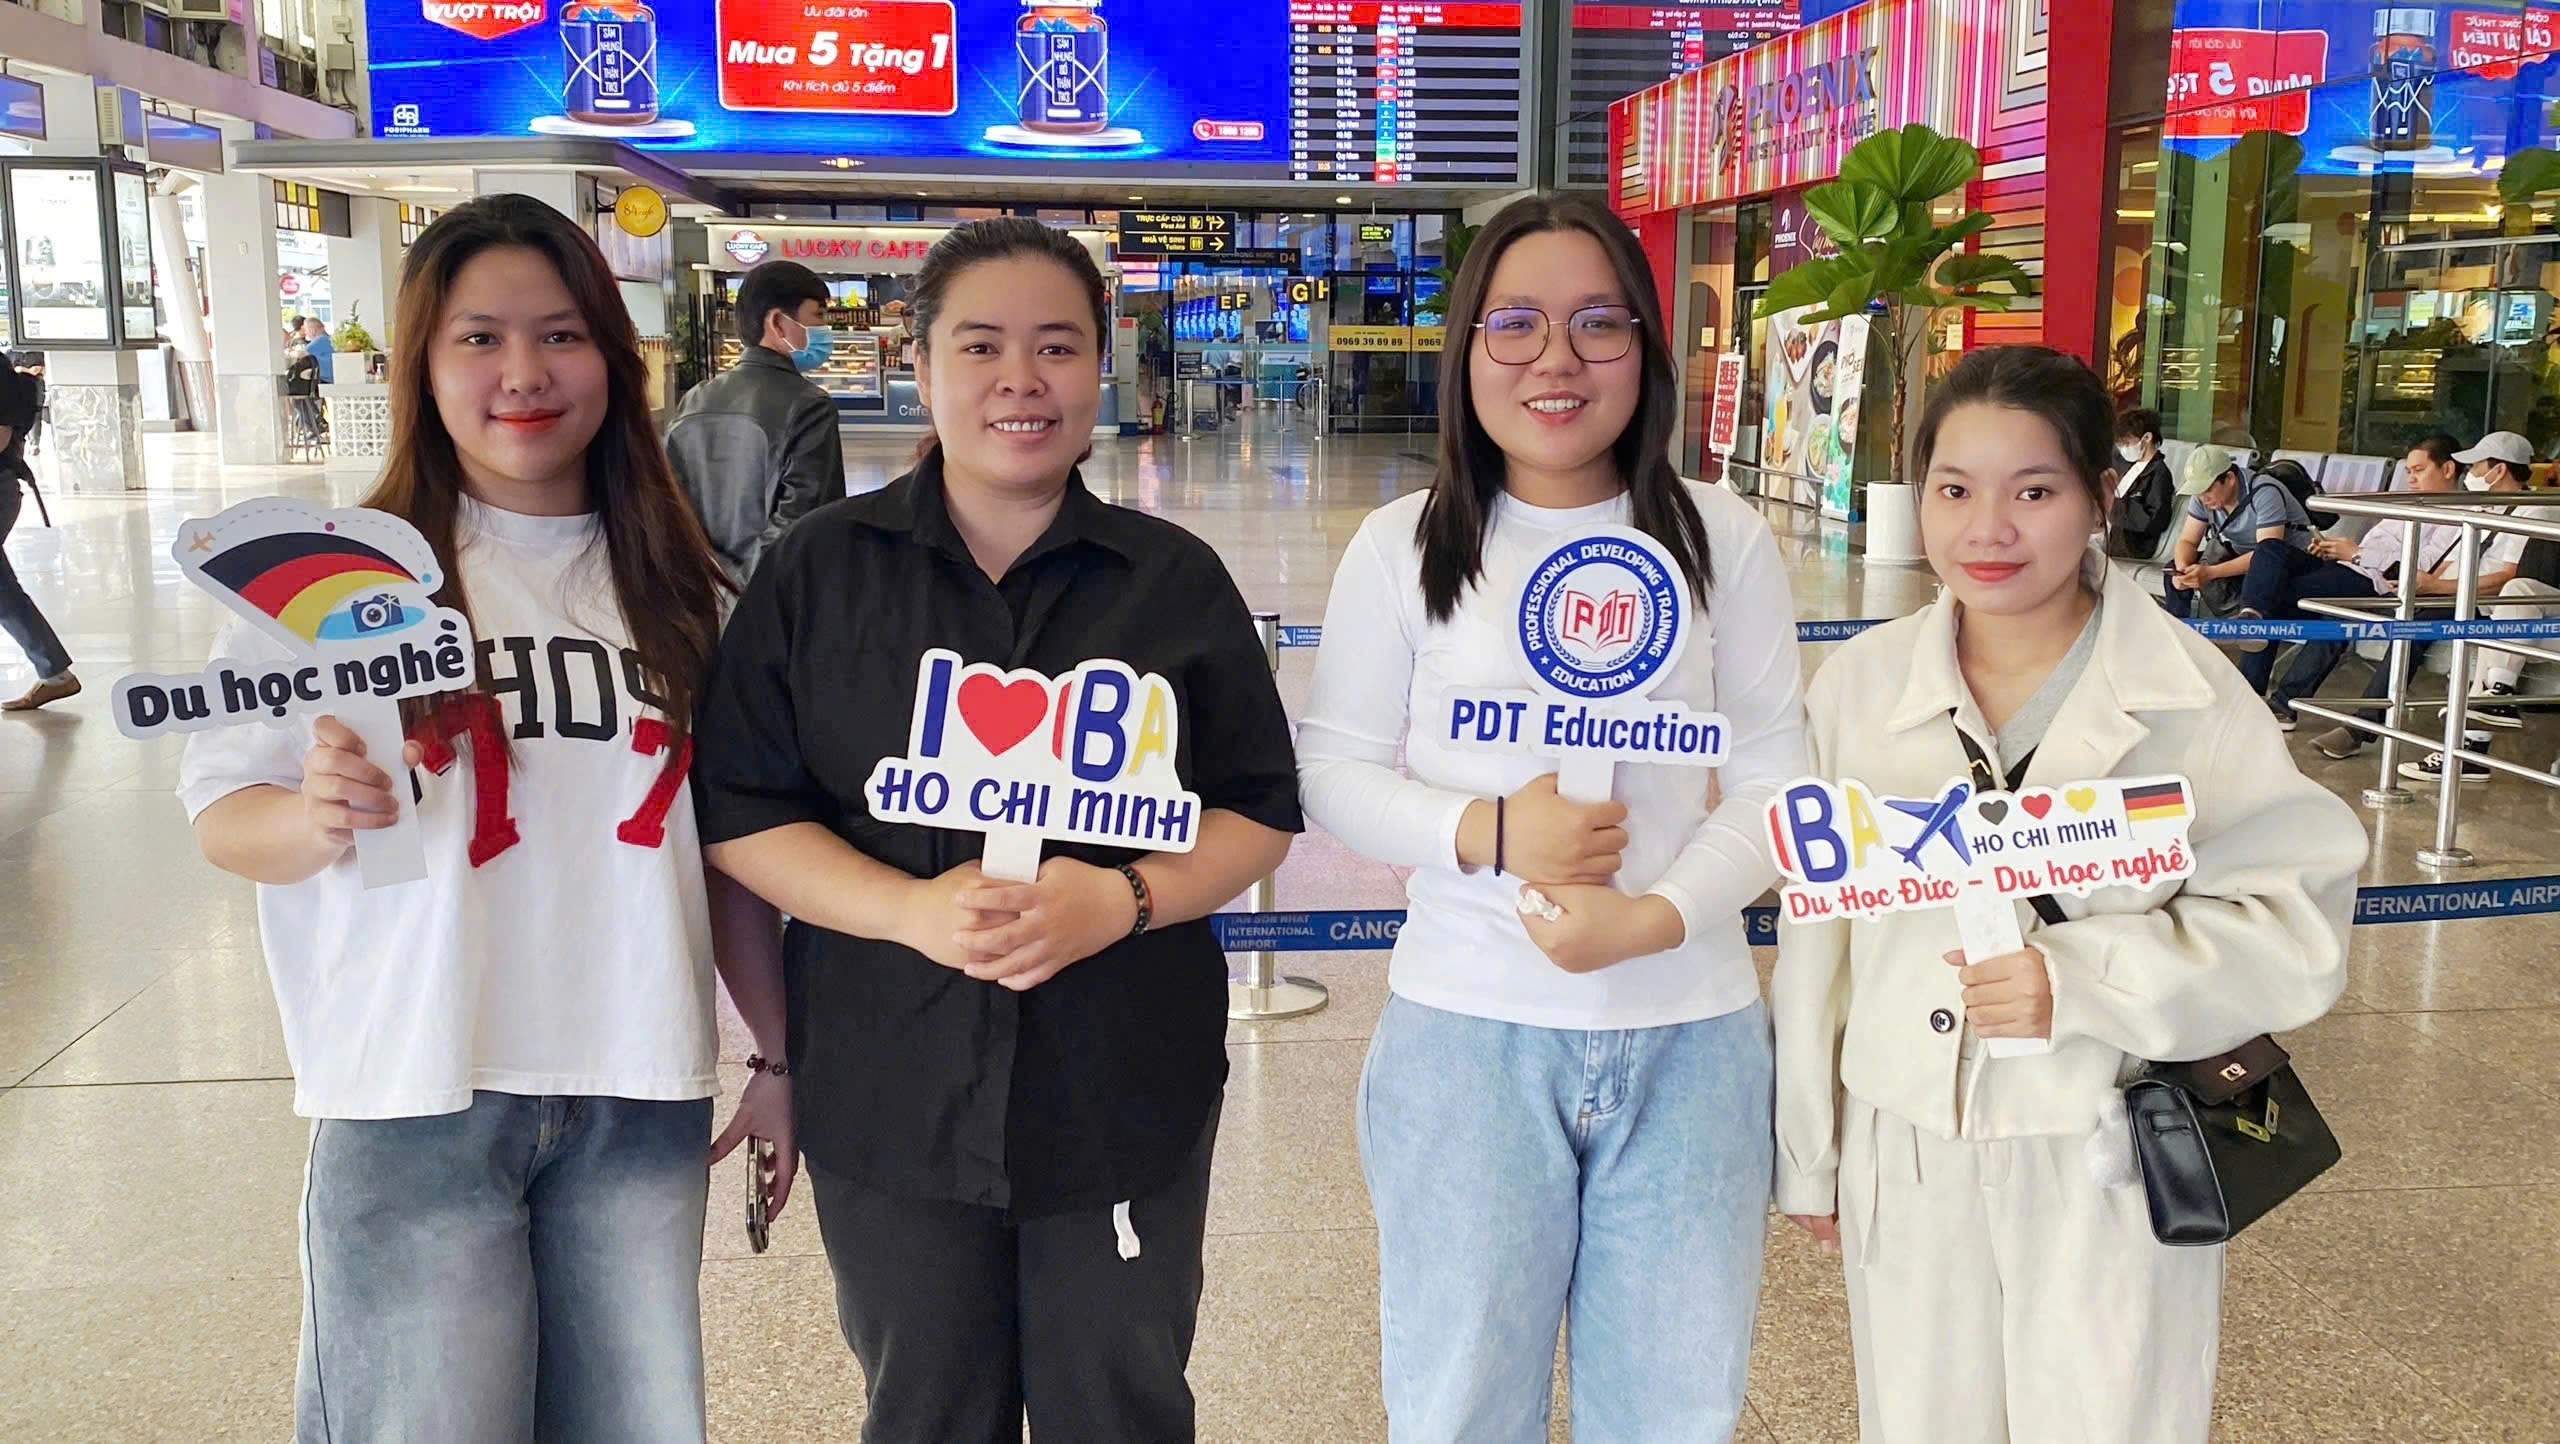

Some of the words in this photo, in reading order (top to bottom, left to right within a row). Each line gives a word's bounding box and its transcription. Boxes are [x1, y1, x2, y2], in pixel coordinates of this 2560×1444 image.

[804, 6, 821, 18] Ưu
[848, 7, 869, 18] lớn
[727, 40, 798, 65] Mua
[808, 31, 839, 66] 5
[850, 43, 925, 74] Tặng
[931, 33, 950, 68] 1
[783, 80, 804, 92] Khi
[805, 80, 828, 92] tích
[832, 80, 849, 94] đủ
[852, 82, 861, 93] 5
[863, 80, 897, 94] điểm
[1747, 46, 1878, 134] PHOENIX
[781, 238, 862, 259] LUCKY
[866, 239, 930, 260] CAFE
[1280, 252, 1296, 264] D4
[1221, 296, 1231, 310] E
[1236, 294, 1248, 308] F
[1292, 283, 1308, 302] G
[1580, 543, 1664, 588] DEVELOPING
[1525, 551, 1578, 652] PROFESSIONAL
[1648, 587, 1673, 658] TRAINING
[1812, 626, 1839, 636] SON
[1842, 624, 1871, 636] NHA
[2212, 622, 2238, 634] TÂN
[2240, 624, 2266, 635] SƠN
[2340, 623, 2388, 638] TIA
[2442, 624, 2464, 635] TAN
[2468, 624, 2494, 635] SON
[2496, 624, 2528, 634] NHAT
[126, 684, 211, 728] Du
[220, 666, 323, 718] học
[334, 619, 466, 697] nghề
[1550, 668, 1636, 692] EDUCATION
[920, 658, 952, 758] I
[1450, 698, 1528, 743] PDT
[1544, 703, 1722, 755] Education
[876, 766, 950, 815] HO
[969, 778, 1051, 828] CHI
[1068, 788, 1192, 843] MINH
[1972, 829, 2004, 855] HO
[2012, 824, 2052, 850] CHI
[2056, 818, 2117, 844] MINH
[1788, 890, 1832, 918] Du
[1838, 883, 1895, 916] Học
[1898, 873, 1959, 906] Đức
[1993, 864, 2042, 893] Du
[2048, 857, 2104, 892] học
[2110, 837, 2189, 885] nghề
[1228, 926, 1316, 937] INTERNATIONAL
[1330, 916, 1401, 941] CẢNG
[1229, 939, 1278, 949] AIRPORT
